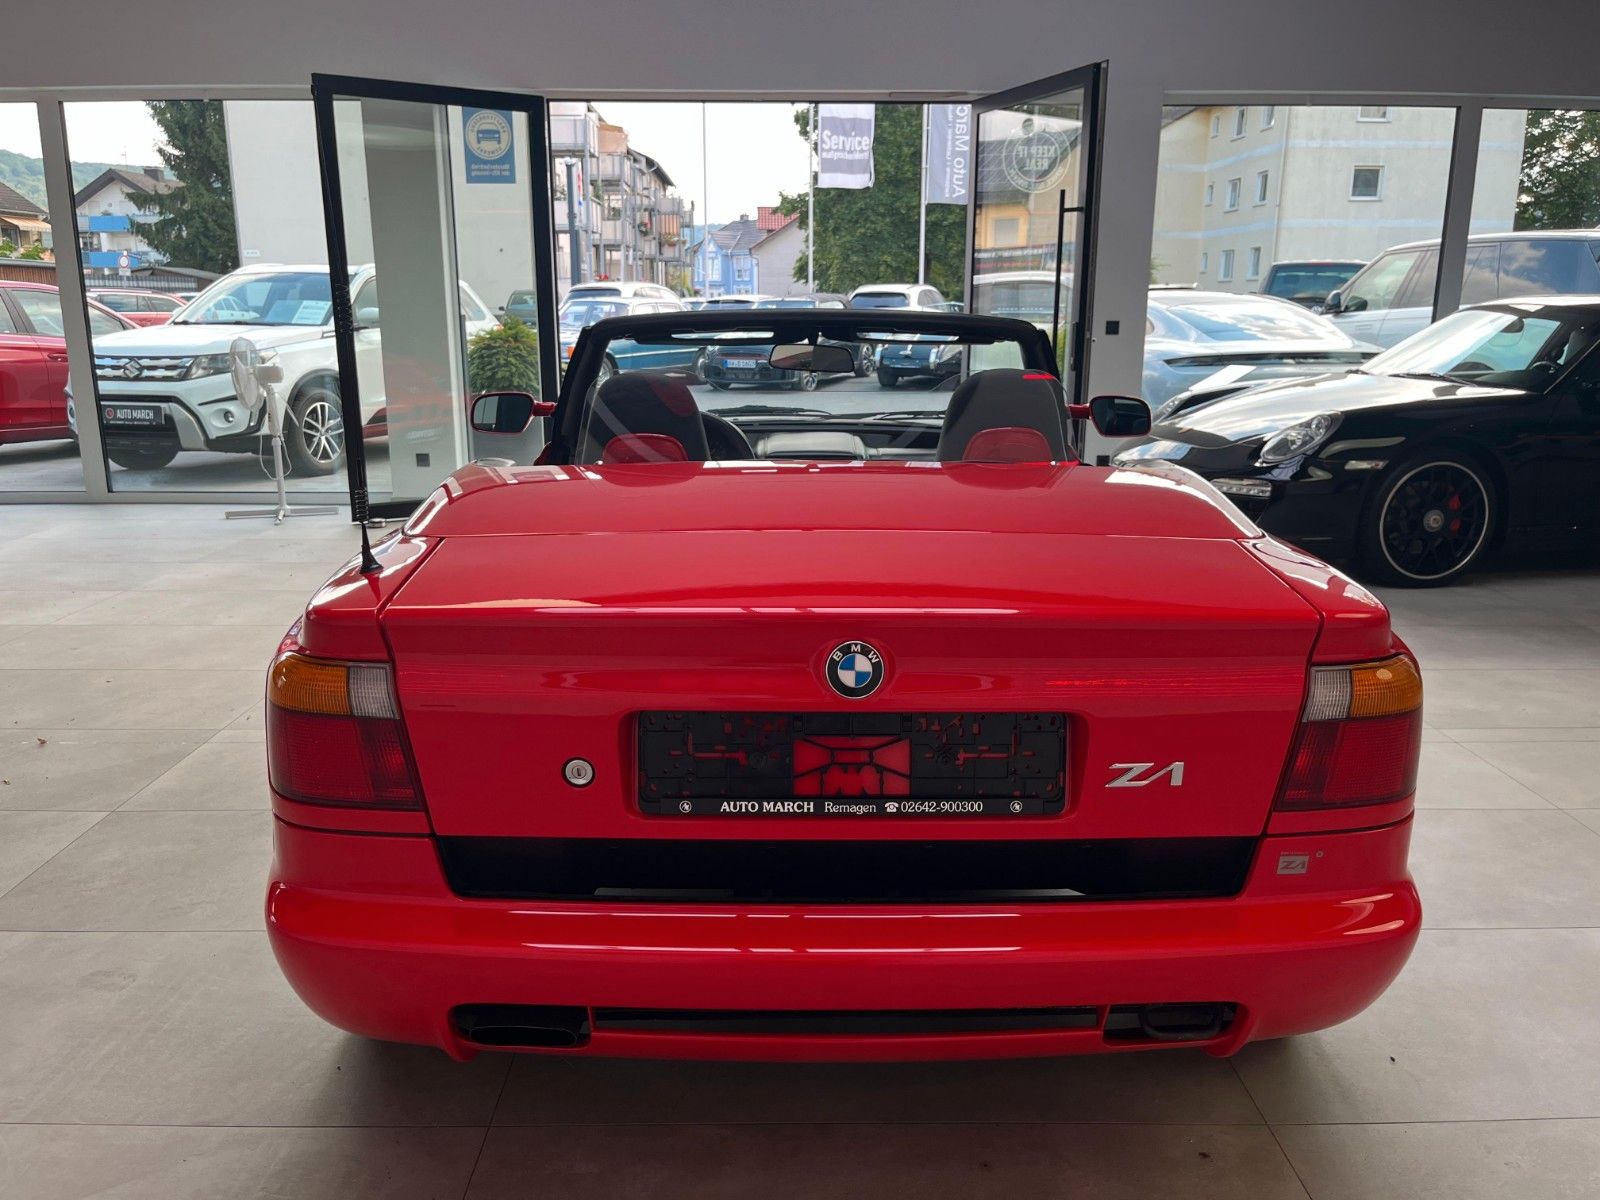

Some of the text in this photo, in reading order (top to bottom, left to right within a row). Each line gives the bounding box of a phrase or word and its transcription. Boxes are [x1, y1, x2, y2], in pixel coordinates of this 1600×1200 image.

[822, 130, 870, 151] Service
[117, 409, 154, 420] AUTO MARCH
[832, 643, 880, 664] BMW
[1104, 761, 1185, 788] Z1
[720, 801, 983, 815] AUTO MARCH Remagen 02642-900300
